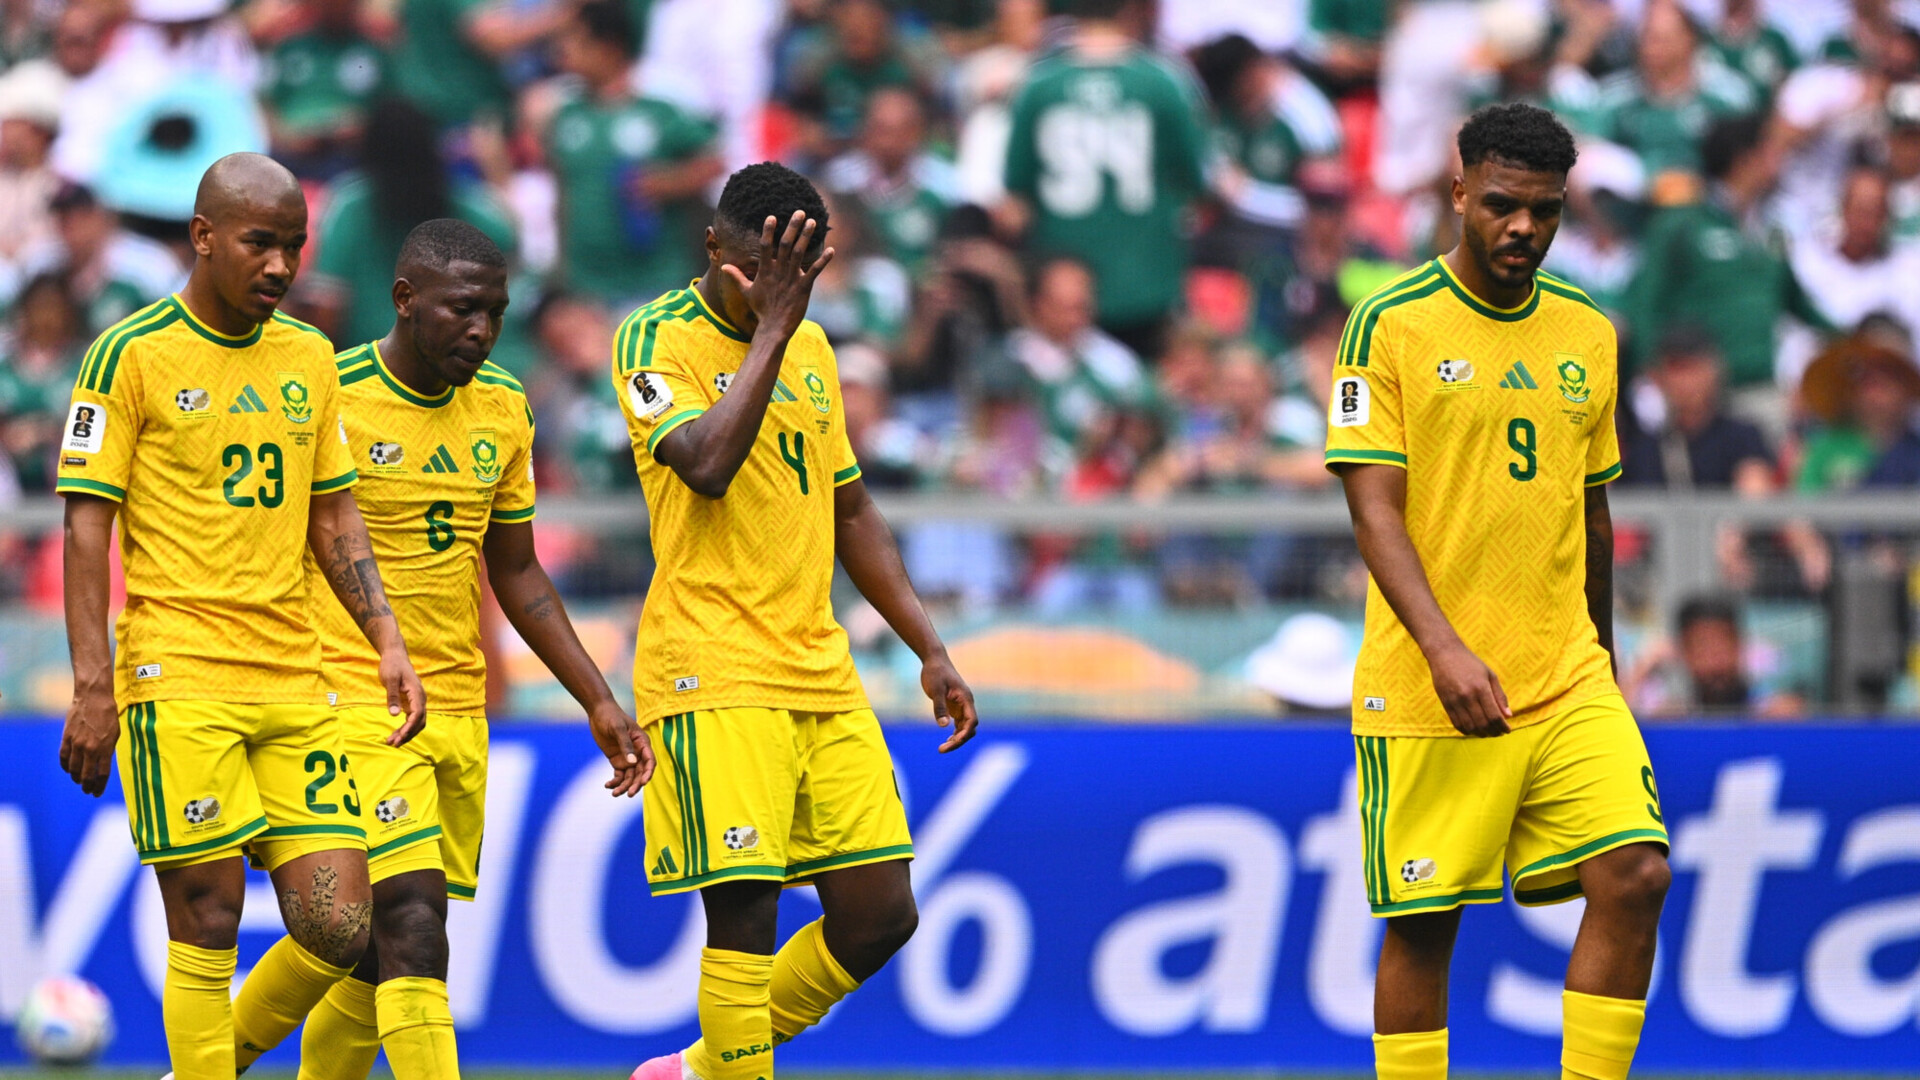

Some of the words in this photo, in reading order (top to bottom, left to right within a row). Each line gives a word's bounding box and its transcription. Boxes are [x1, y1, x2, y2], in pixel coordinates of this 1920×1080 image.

[222, 442, 284, 509] 23
[778, 431, 809, 496] 4
[1508, 417, 1537, 482] 9
[425, 500, 457, 552] 6
[304, 750, 362, 817] 23
[446, 742, 1031, 1036] 10%
[1092, 762, 1382, 1037] at
[720, 1043, 772, 1062] SAFA
